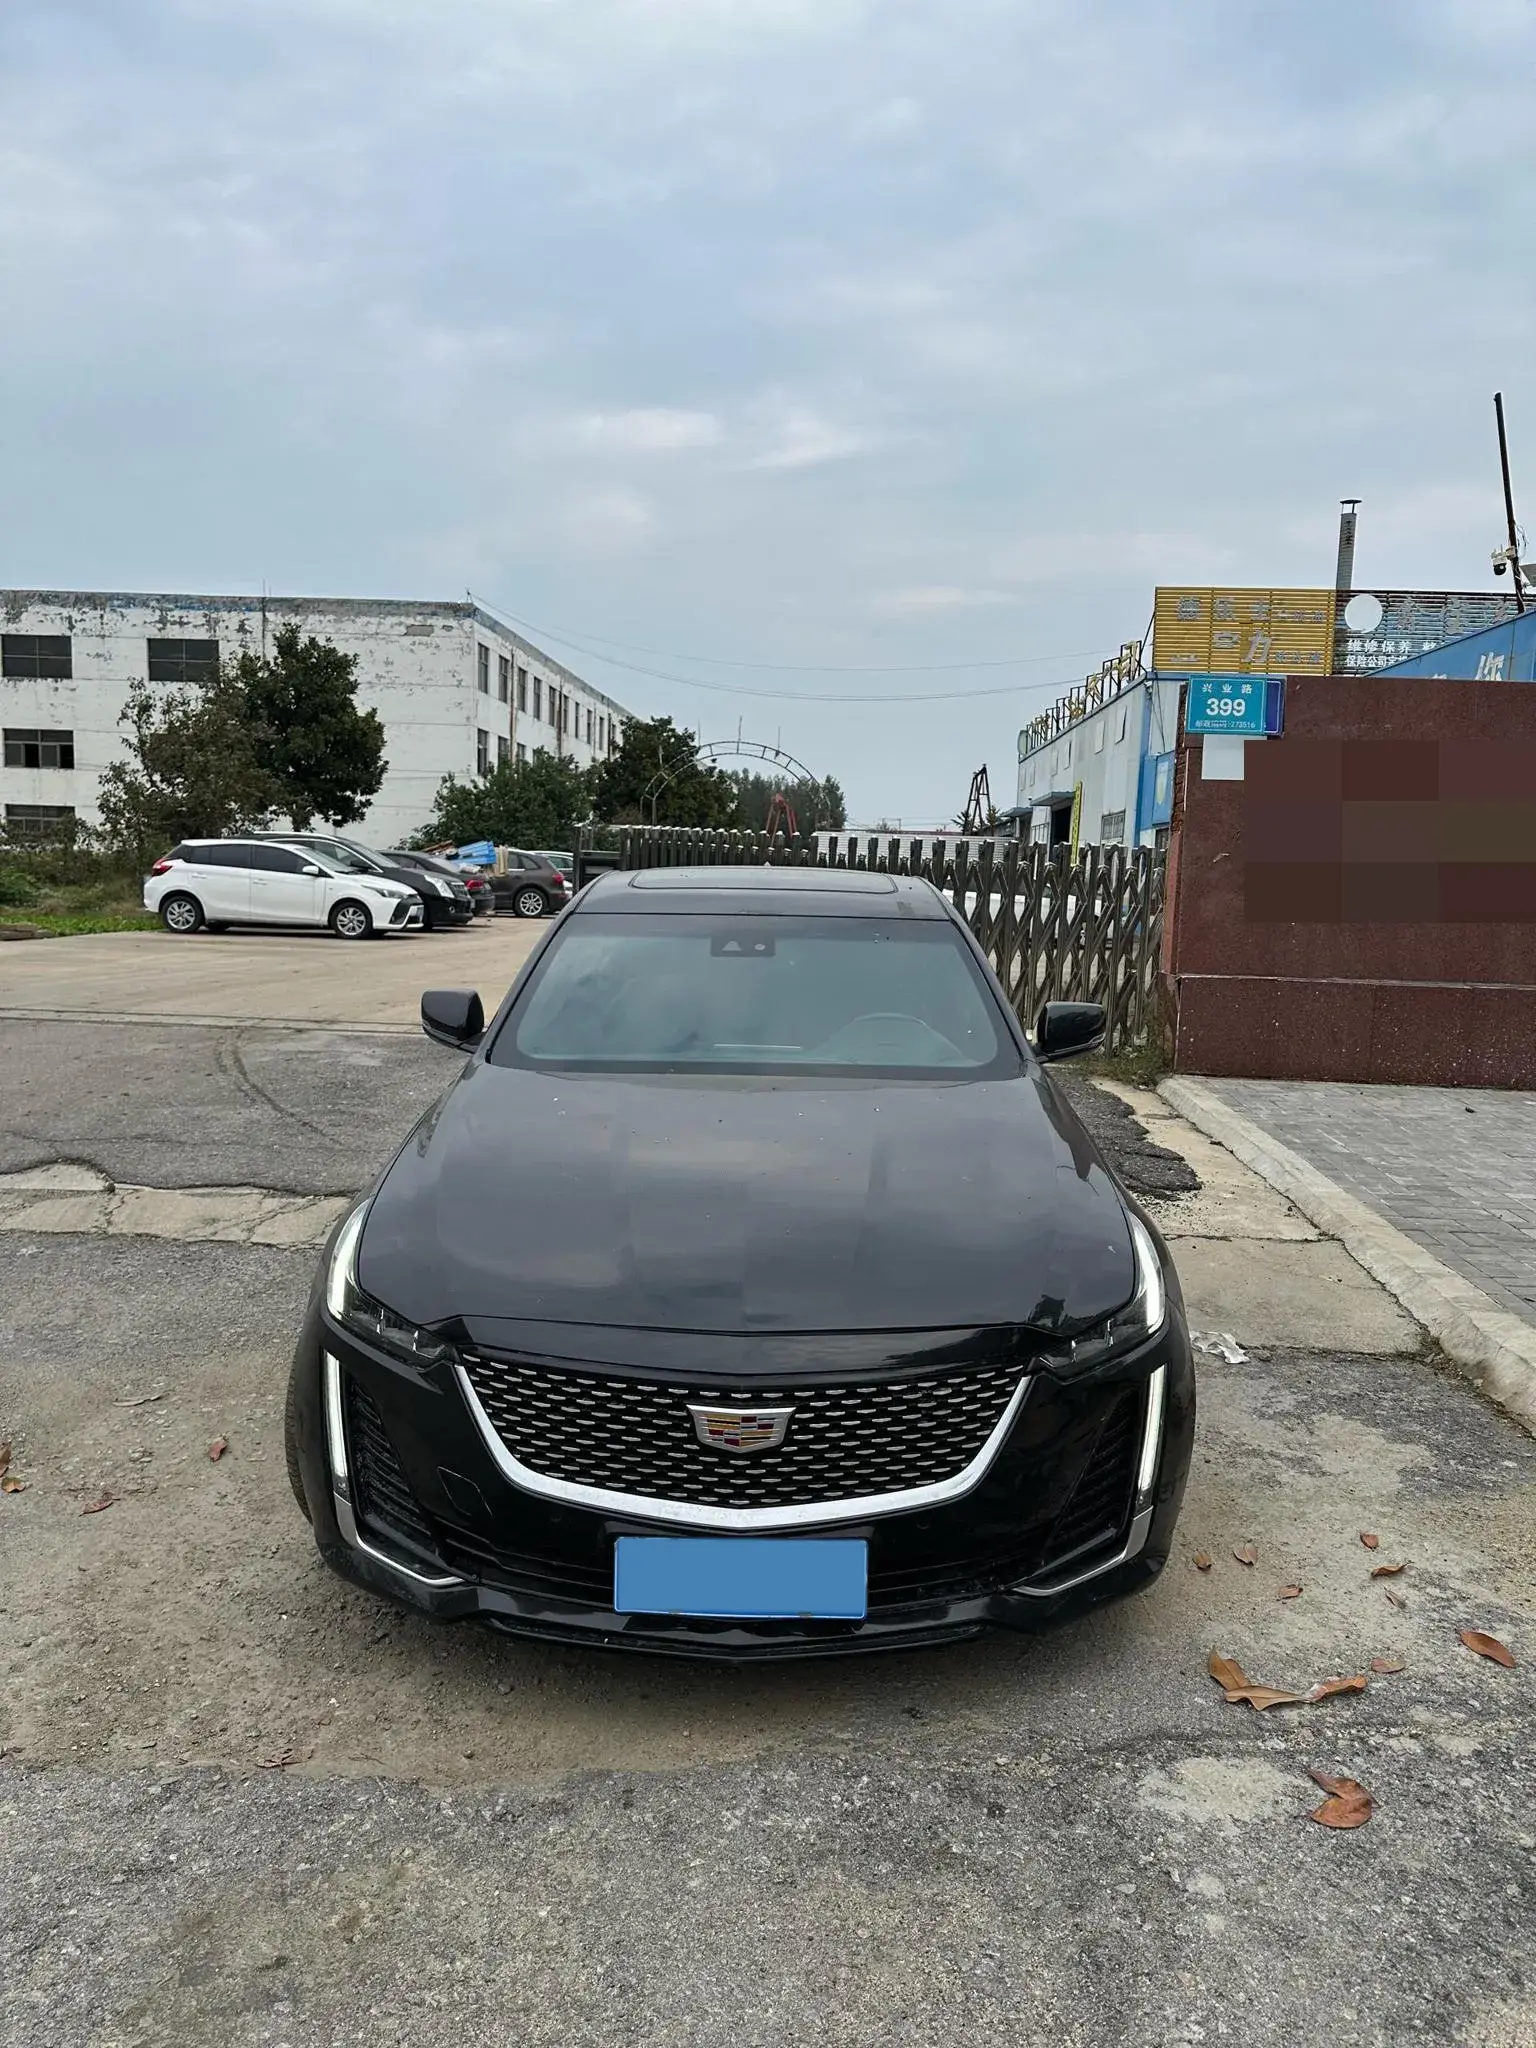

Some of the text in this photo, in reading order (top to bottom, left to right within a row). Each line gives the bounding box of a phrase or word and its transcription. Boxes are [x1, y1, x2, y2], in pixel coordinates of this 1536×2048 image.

[1347, 639, 1412, 654] 维修保养
[1202, 683, 1253, 694] 兴业路
[1206, 698, 1246, 717] 399
